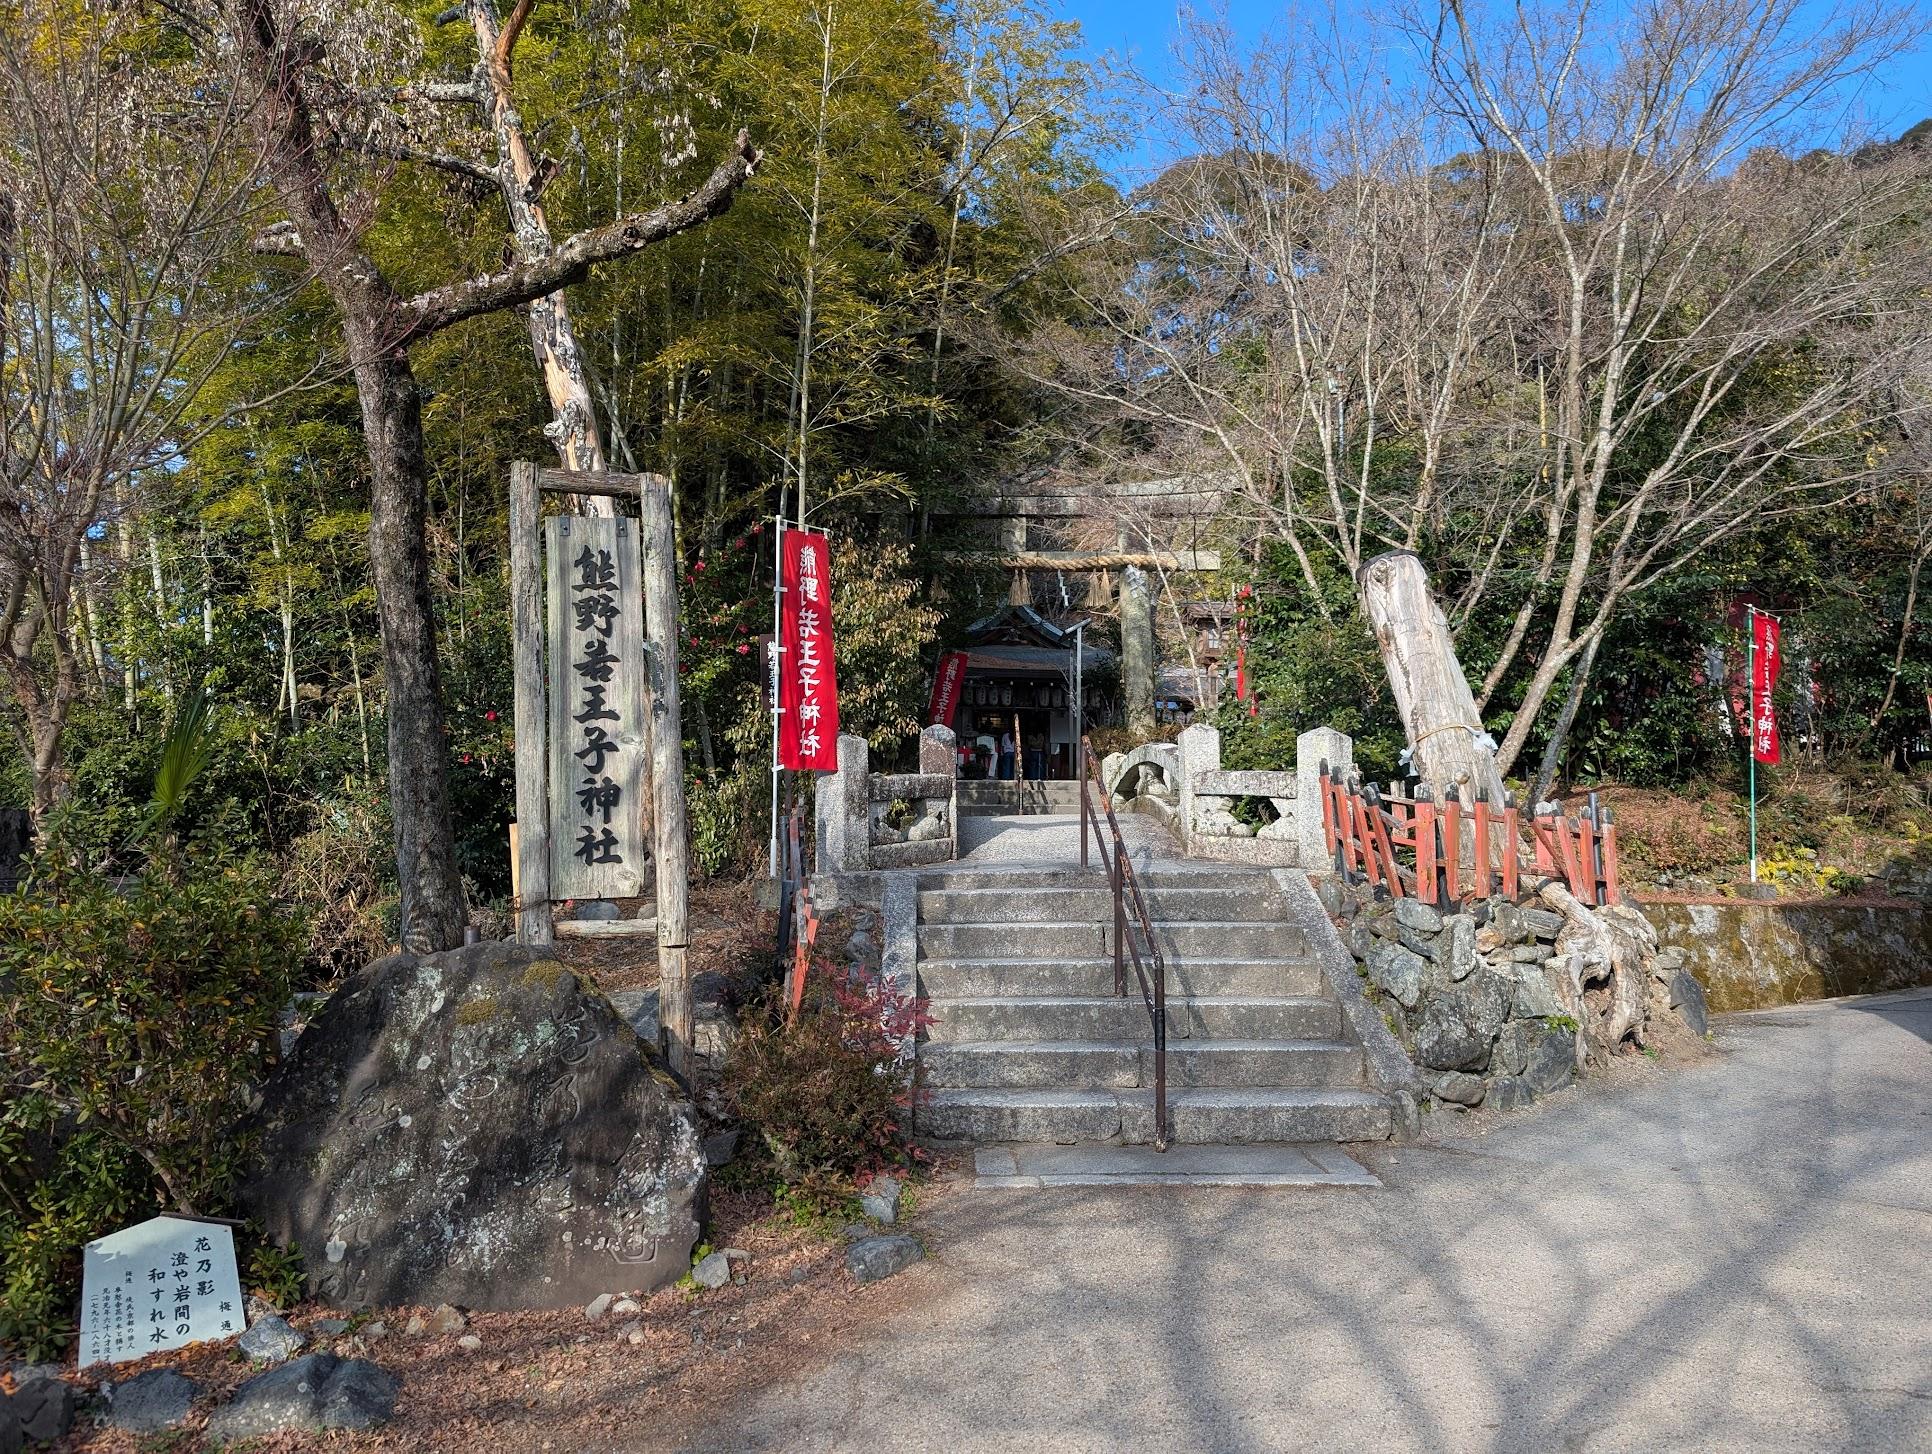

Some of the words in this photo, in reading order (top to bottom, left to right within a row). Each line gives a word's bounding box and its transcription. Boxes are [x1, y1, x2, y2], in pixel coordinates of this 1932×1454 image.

[571, 544, 623, 867] 熊野若王子神社
[170, 1251, 191, 1336] 澄や岩間の
[194, 1236, 216, 1297] 花乃影
[147, 1267, 169, 1344] 和すれ水
[218, 1300, 233, 1332] 梅通
